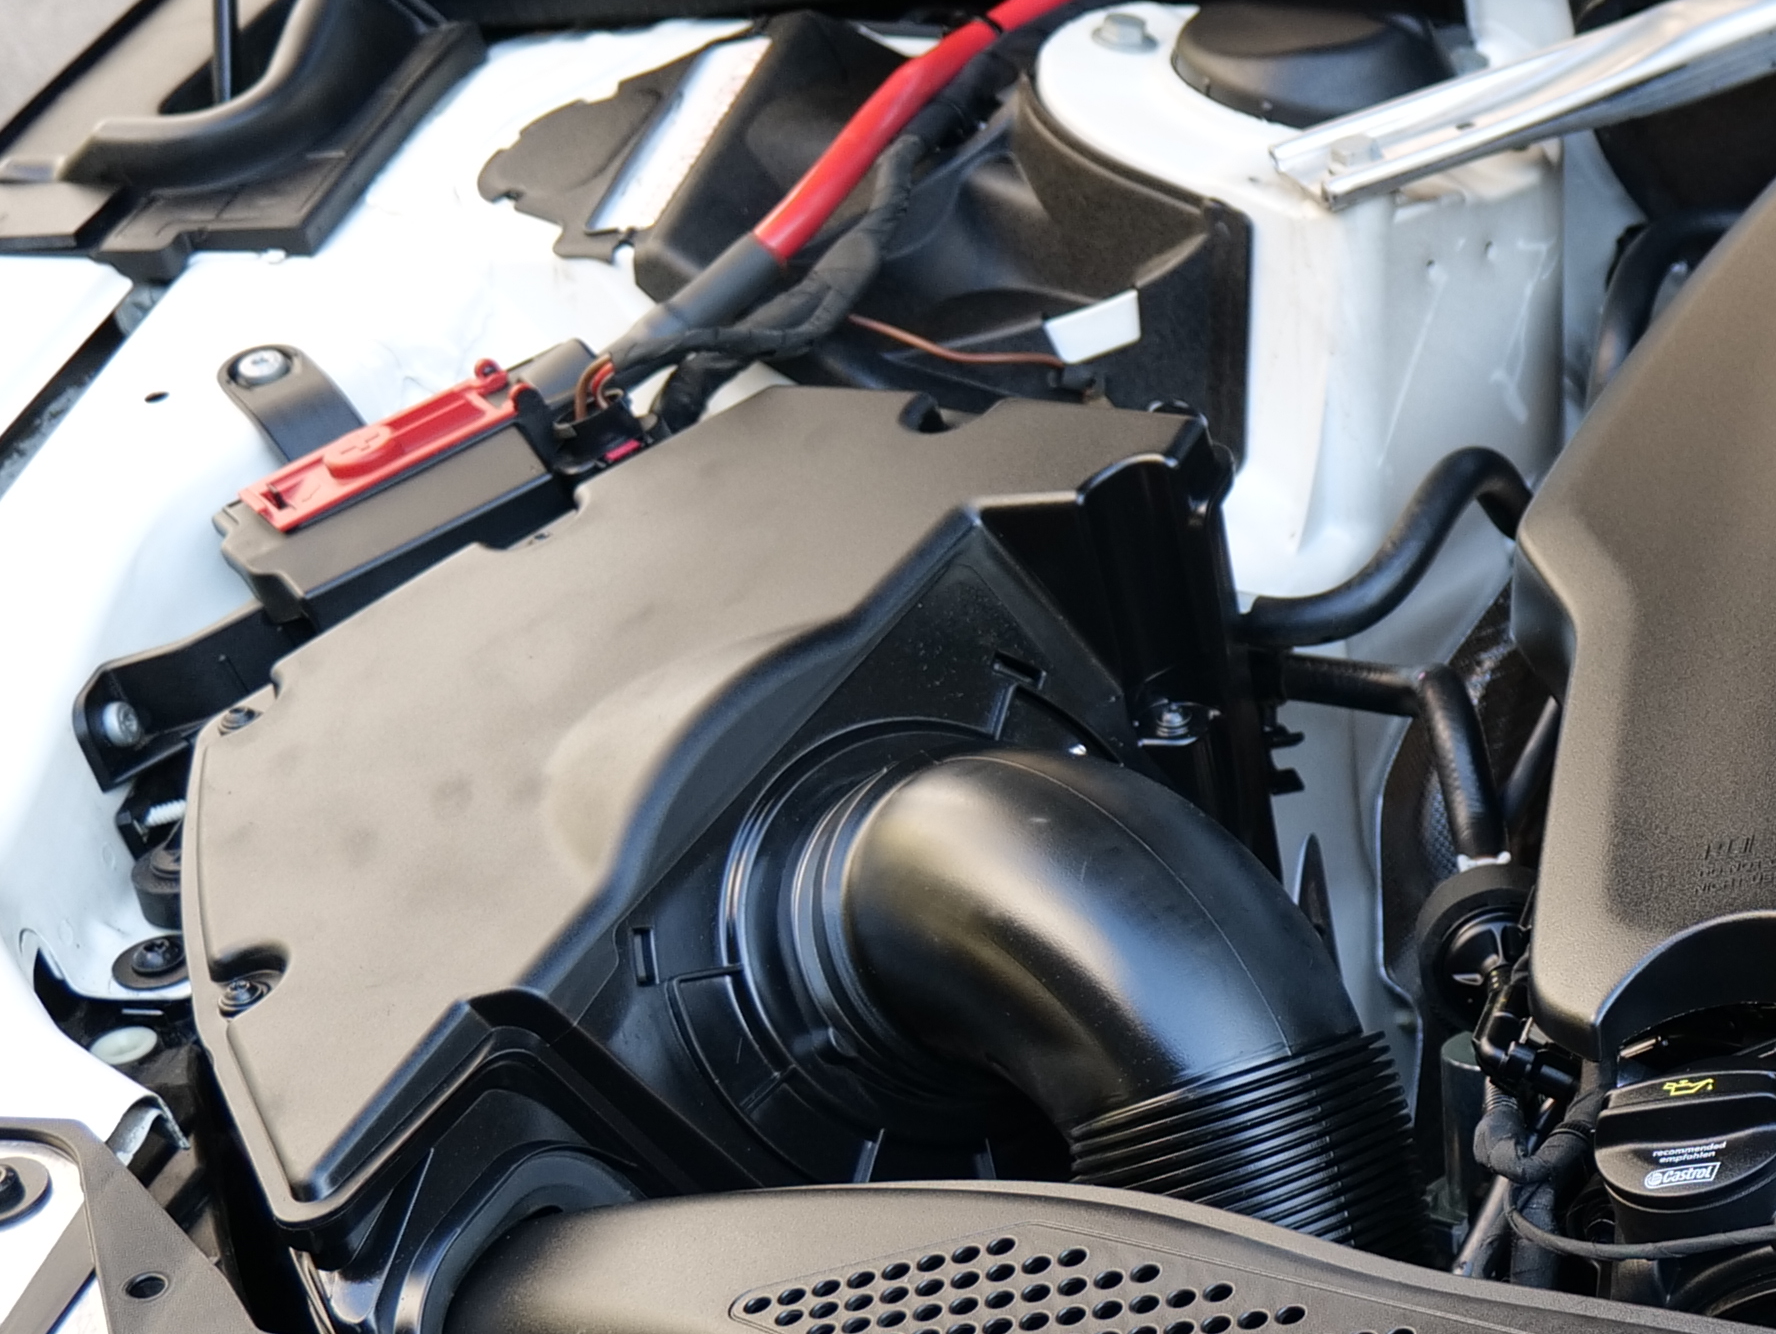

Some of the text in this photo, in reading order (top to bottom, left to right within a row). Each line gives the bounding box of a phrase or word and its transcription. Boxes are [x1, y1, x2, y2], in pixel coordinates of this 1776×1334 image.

[1652, 1140, 1727, 1157] recommended
[1658, 1151, 1716, 1163] empfohlen
[1662, 1165, 1713, 1184] Castrol
